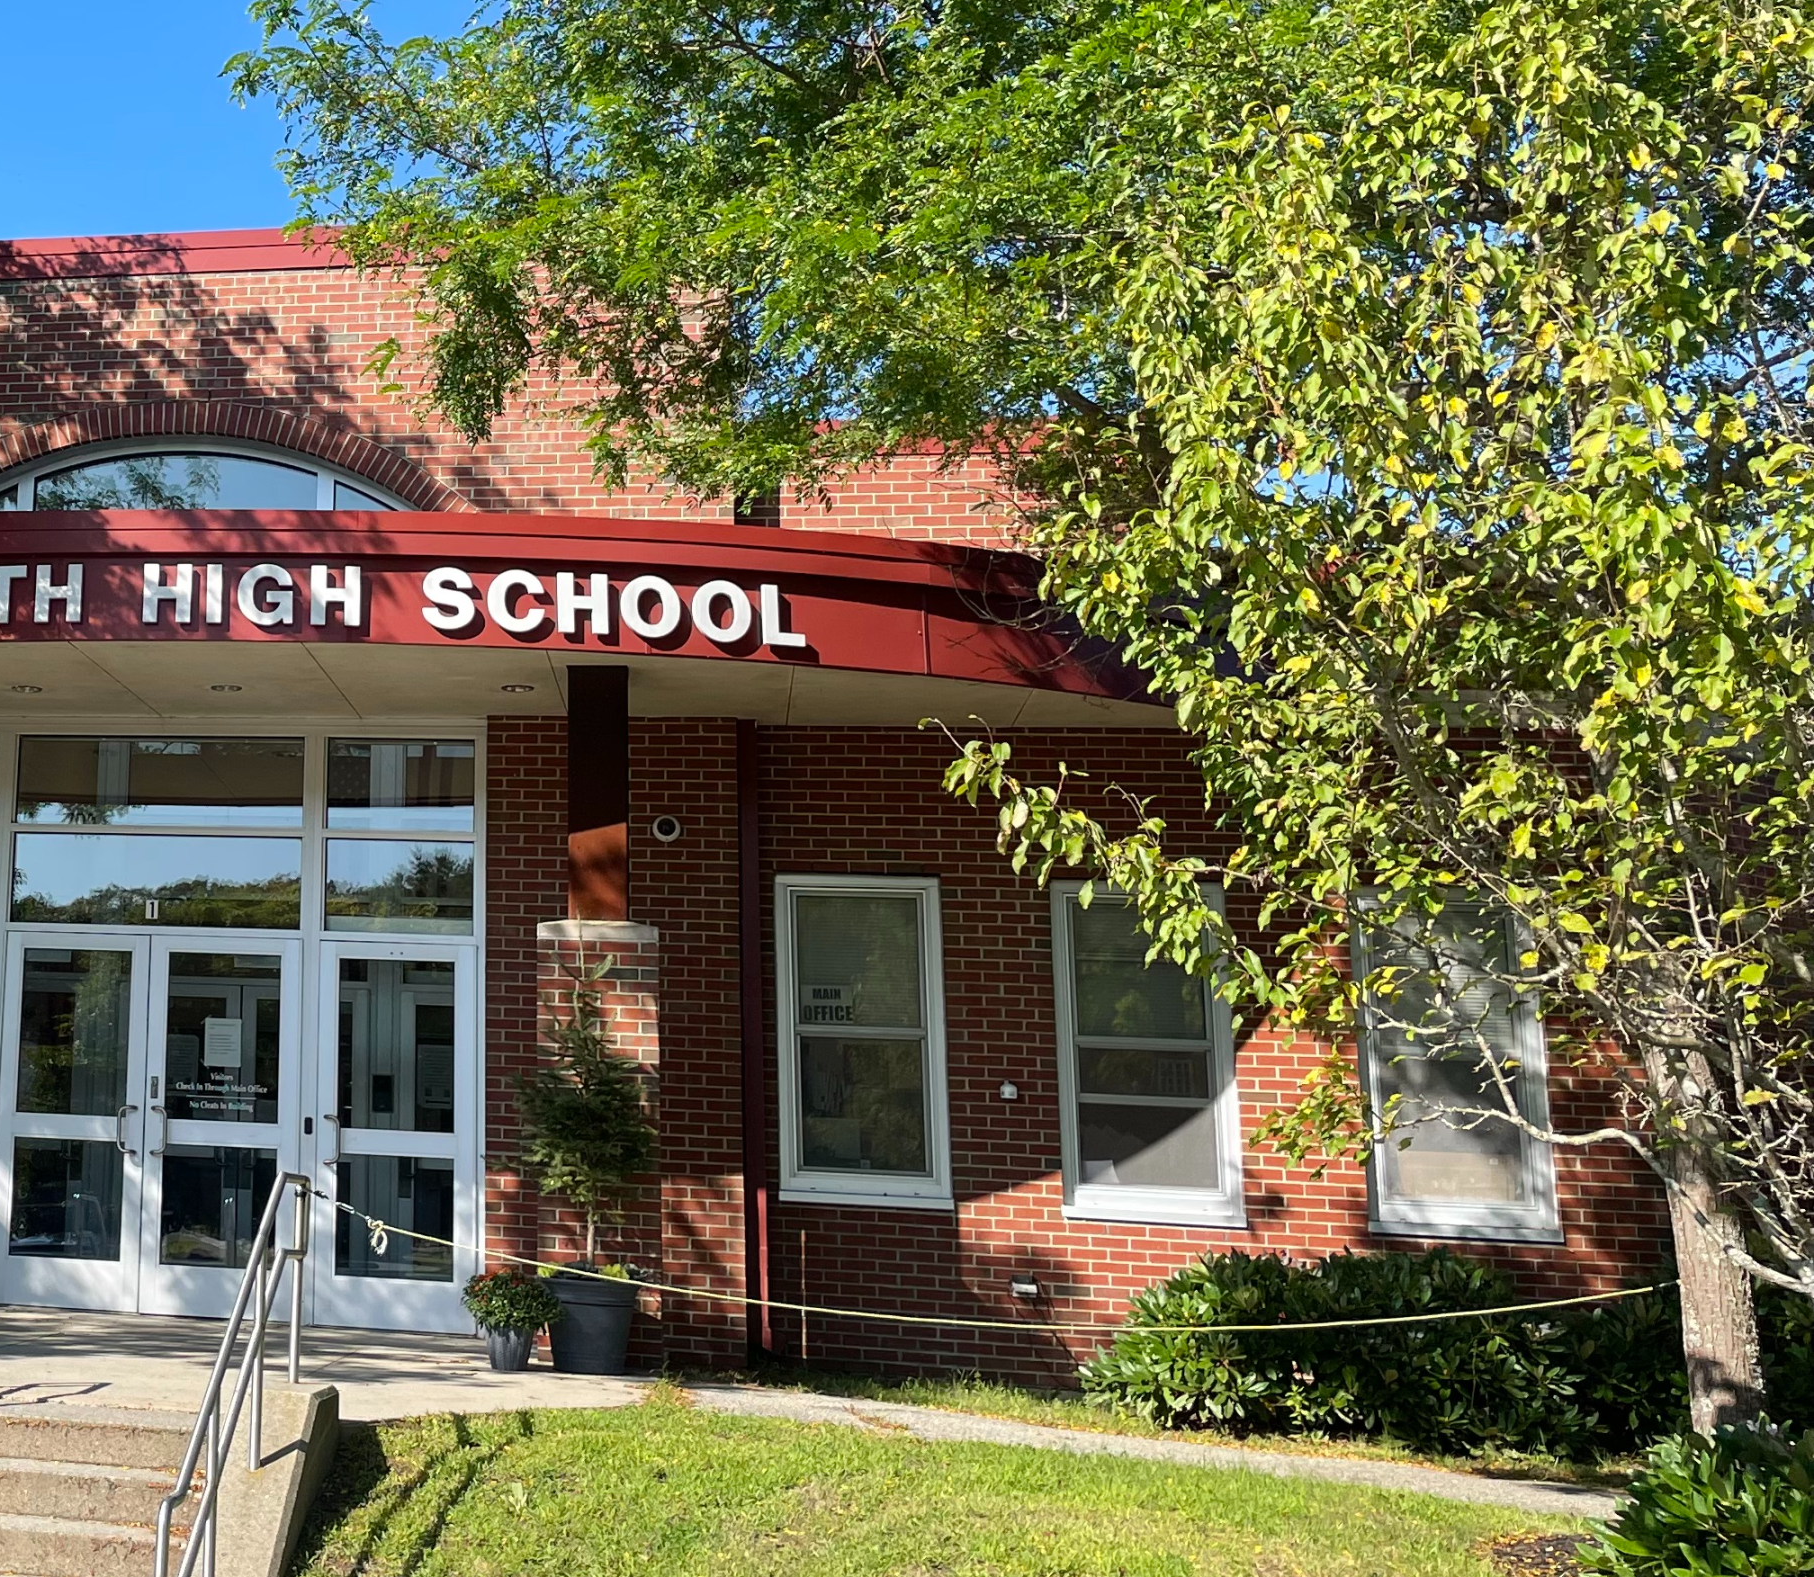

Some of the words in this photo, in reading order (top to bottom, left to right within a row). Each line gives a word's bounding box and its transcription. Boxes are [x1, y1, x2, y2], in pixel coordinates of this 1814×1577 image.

[141, 562, 361, 627] HIGH
[422, 567, 807, 648] SCHOOL
[812, 988, 842, 1000] MAIN
[803, 1004, 854, 1021] OFFICE
[175, 1081, 195, 1090] Check
[230, 1083, 246, 1092] Main
[247, 1084, 268, 1094] Office
[189, 1100, 200, 1109] No
